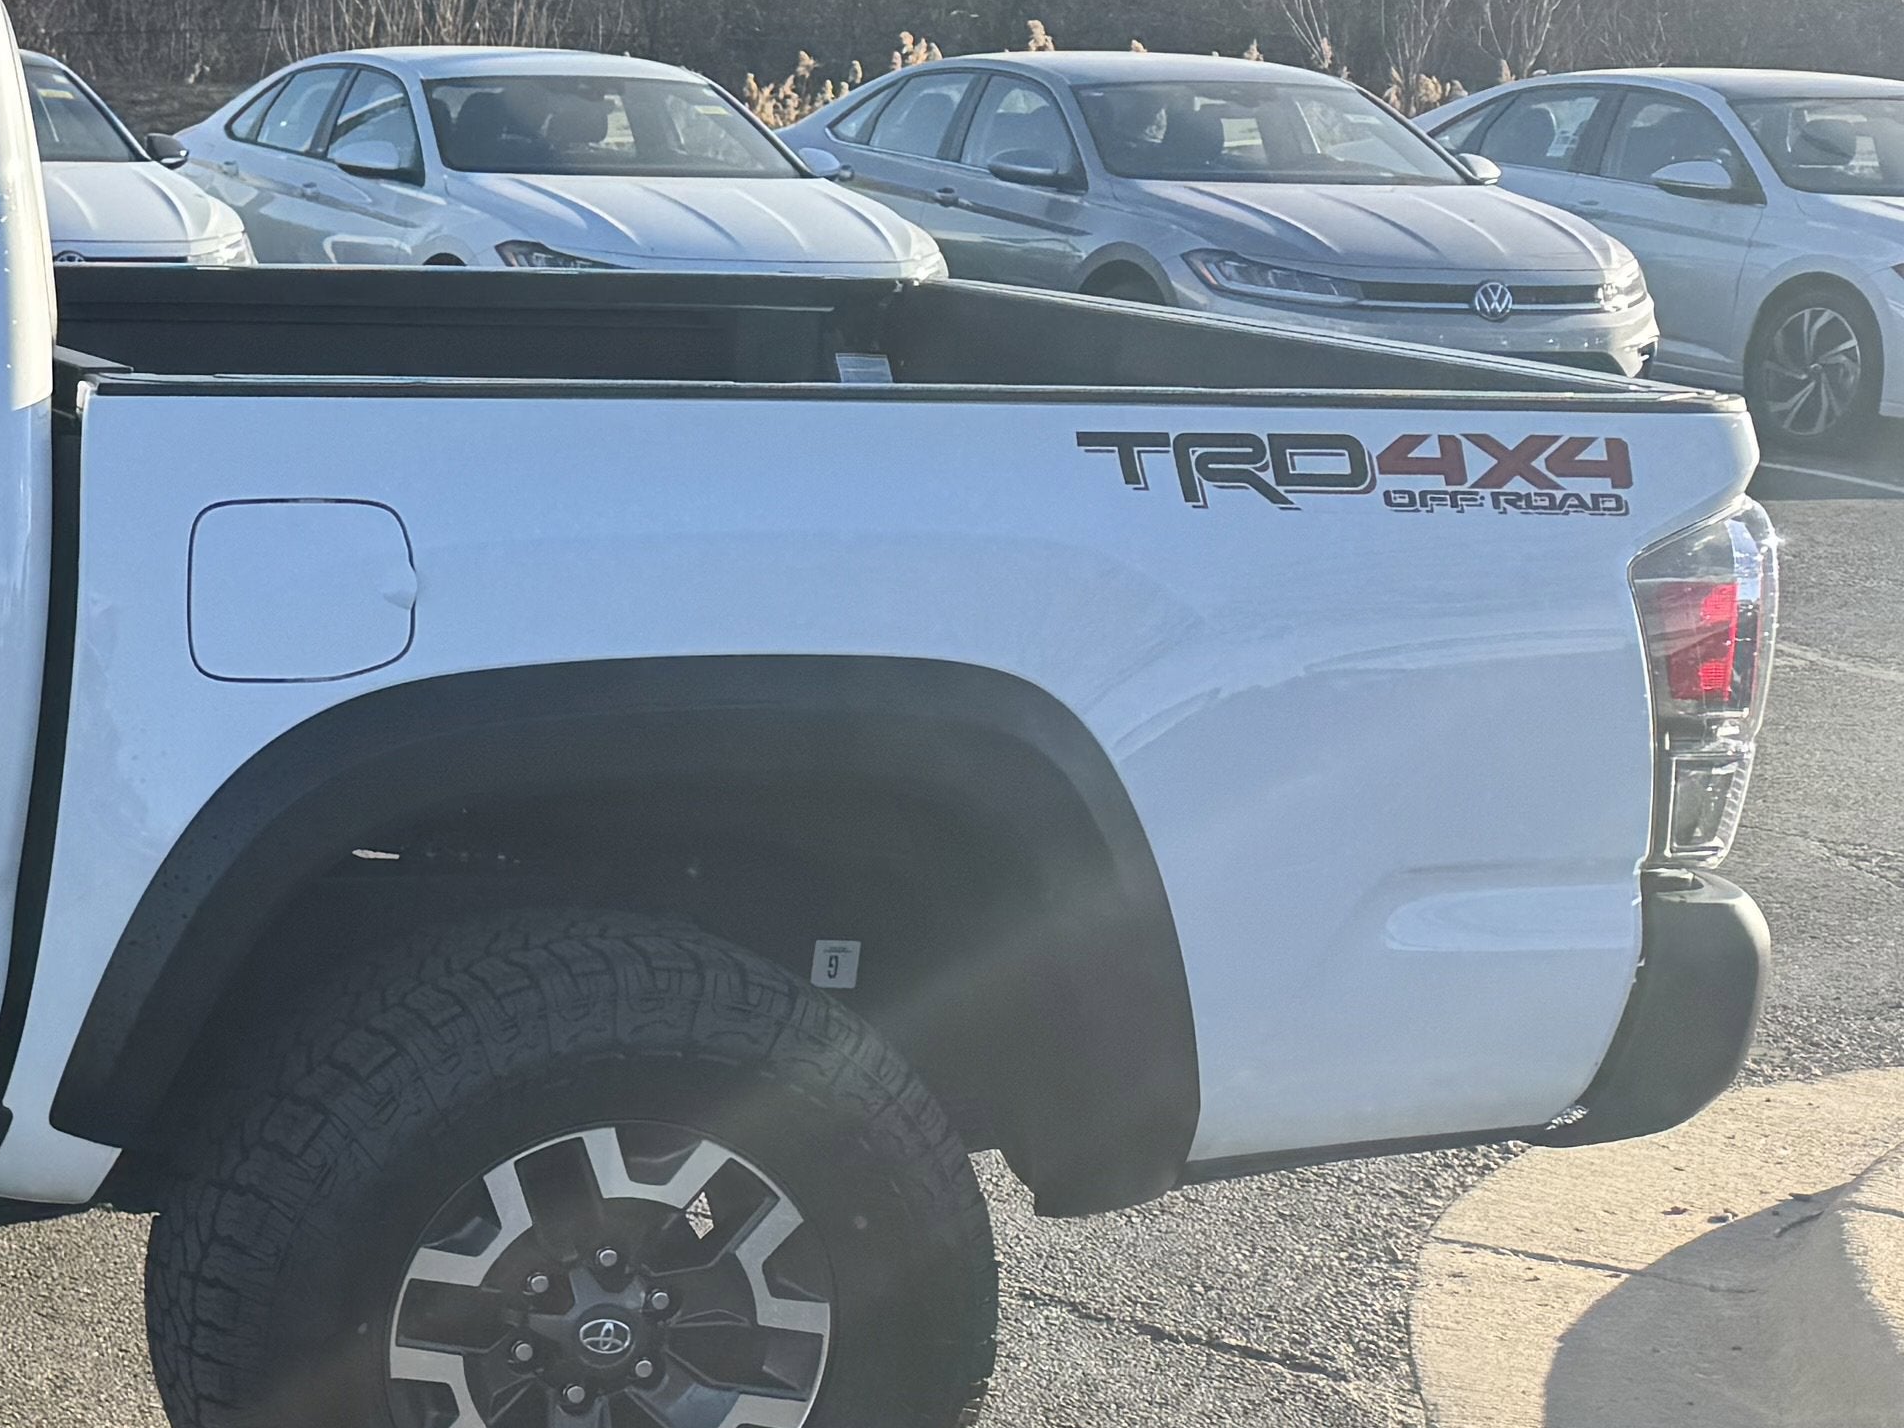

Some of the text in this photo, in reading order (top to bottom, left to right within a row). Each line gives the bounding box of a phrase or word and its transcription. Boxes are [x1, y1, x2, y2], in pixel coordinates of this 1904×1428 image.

[1076, 431, 1376, 512] TRD
[1383, 489, 1631, 517] OFF ROAD
